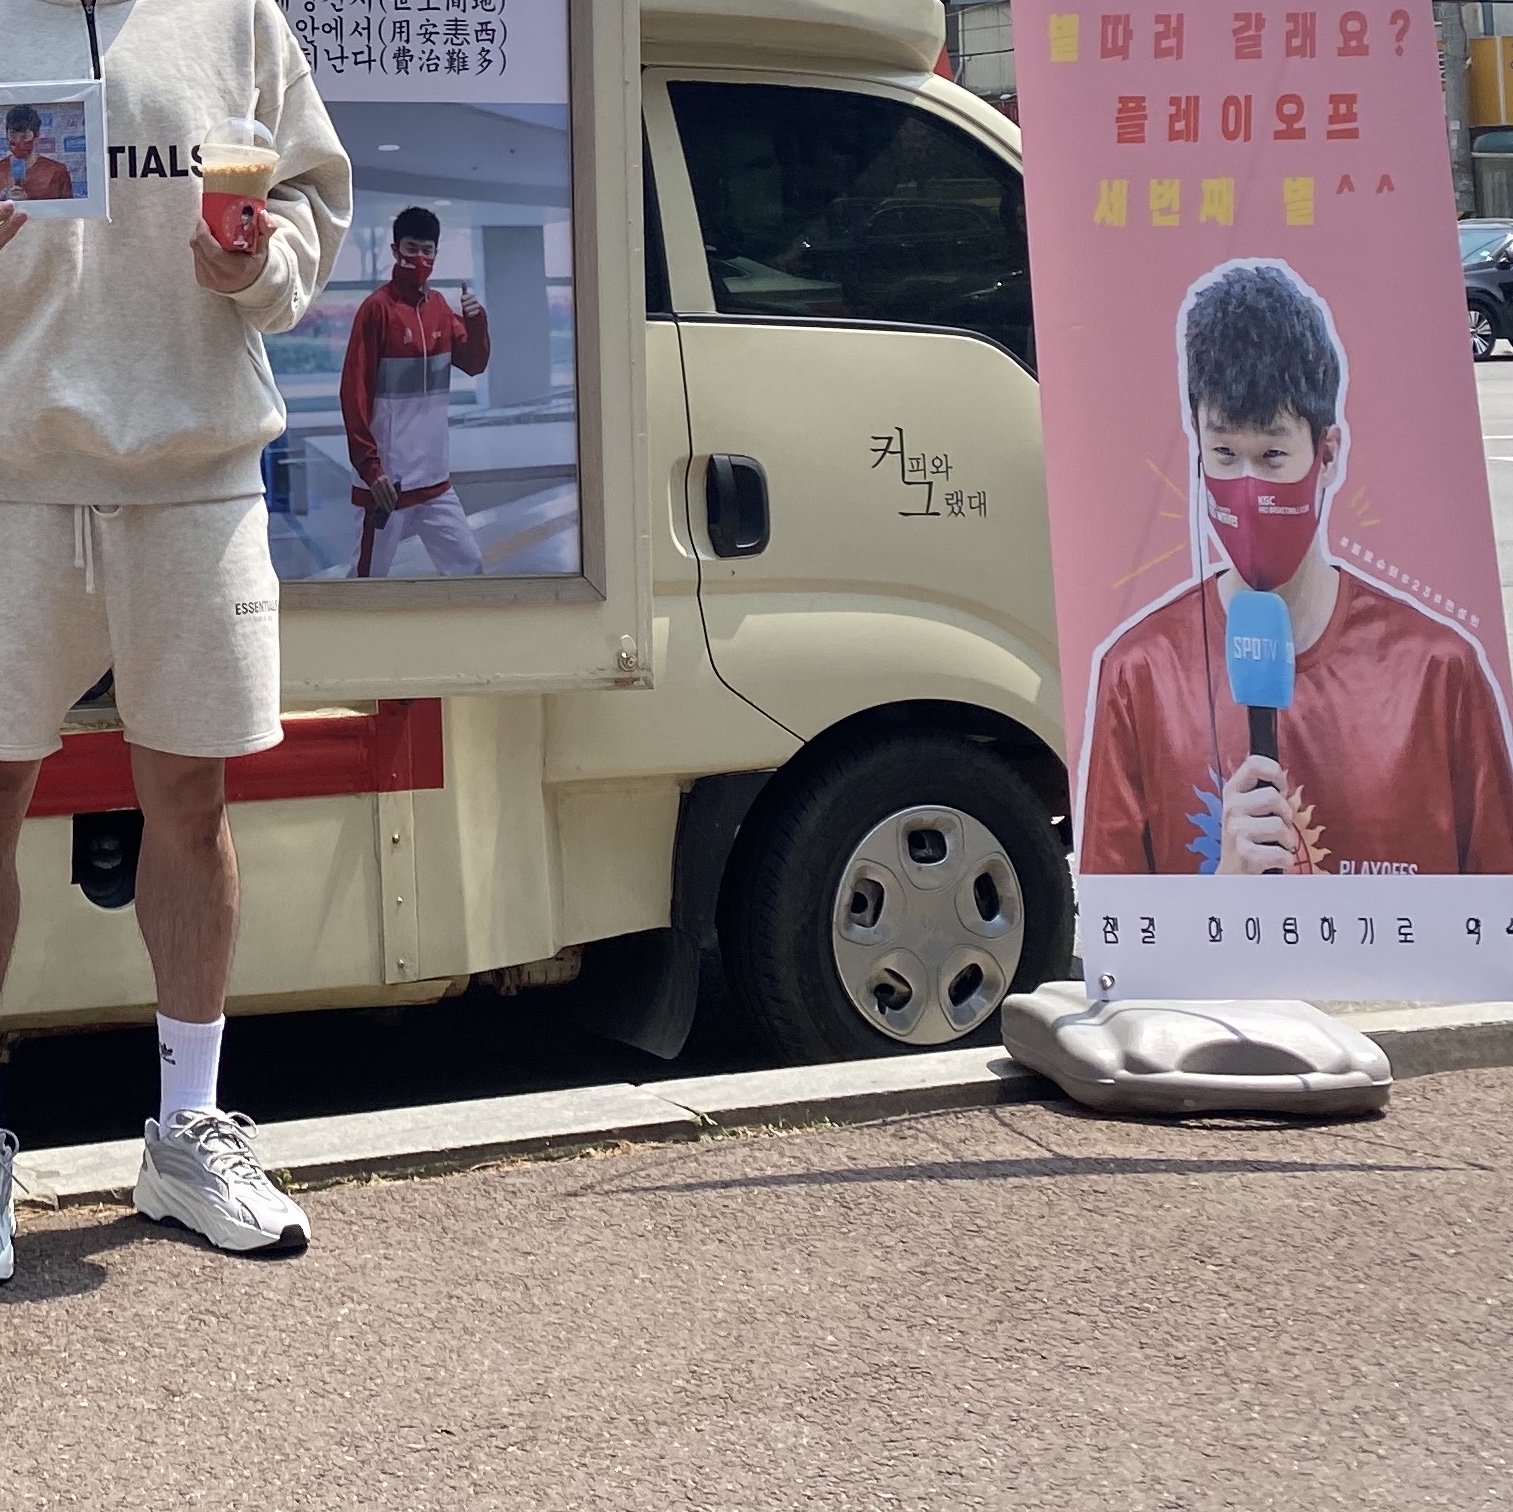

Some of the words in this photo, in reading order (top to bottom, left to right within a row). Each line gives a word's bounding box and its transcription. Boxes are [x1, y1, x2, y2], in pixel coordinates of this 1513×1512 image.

[1230, 8, 1412, 61] 갈래요?
[1114, 93, 1360, 145] 플레이오프
[108, 144, 203, 179] TIALS
[869, 426, 954, 483] 커피와
[1464, 915, 1513, 947] 약
